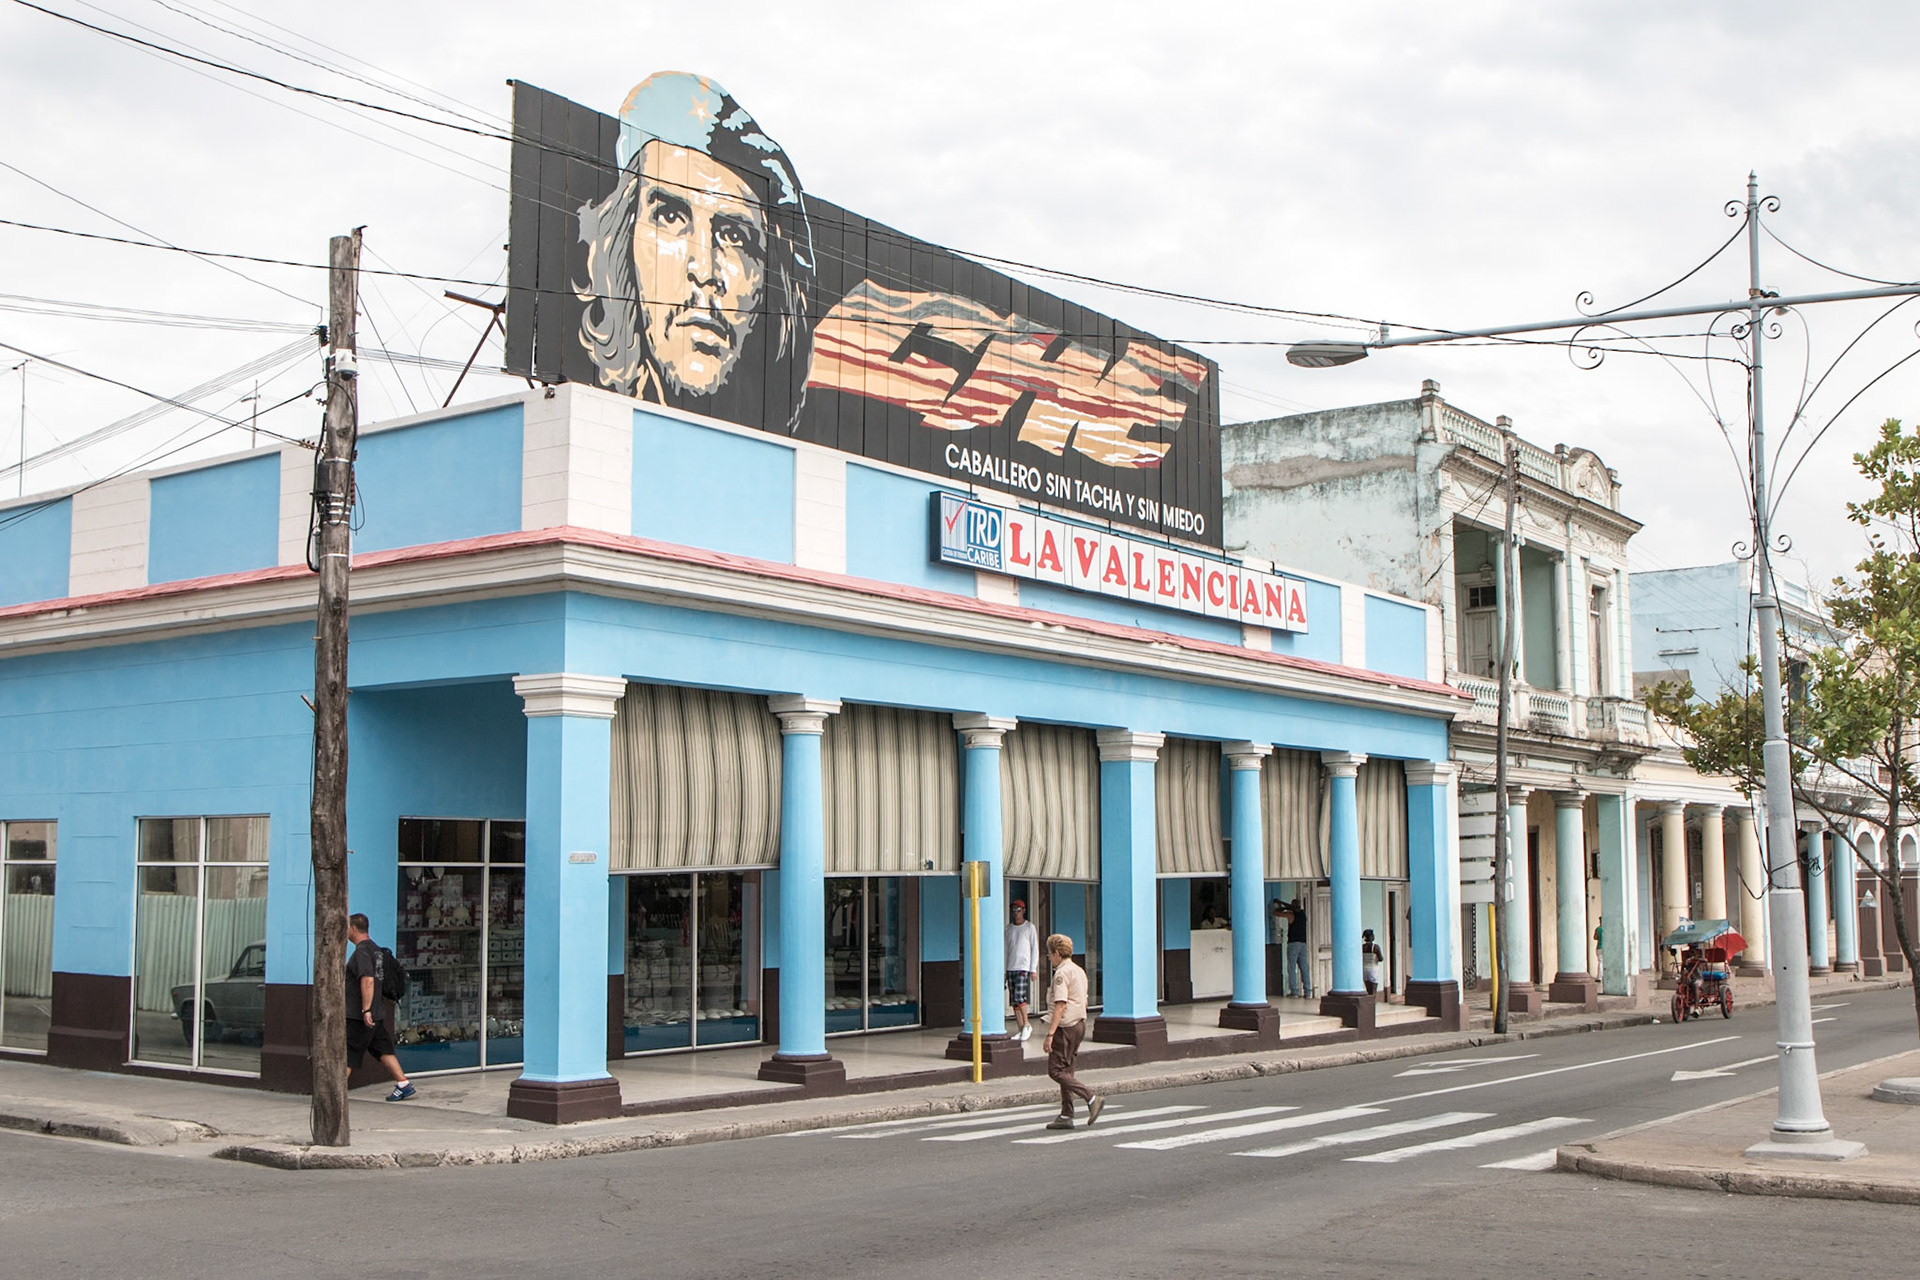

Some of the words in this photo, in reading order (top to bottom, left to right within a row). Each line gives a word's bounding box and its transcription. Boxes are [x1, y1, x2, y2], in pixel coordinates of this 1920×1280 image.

[945, 443, 1042, 491] CABALLERO
[1045, 473, 1072, 500] SIN
[1074, 480, 1124, 514] TACHA
[1126, 493, 1136, 516] Y
[1137, 498, 1159, 524] SIN
[1163, 504, 1205, 535] MIEDO
[967, 547, 1000, 568] CARIBE
[968, 506, 1000, 548] TRD
[1009, 522, 1063, 573] LA
[1074, 537, 1307, 623] VALENCIANA
